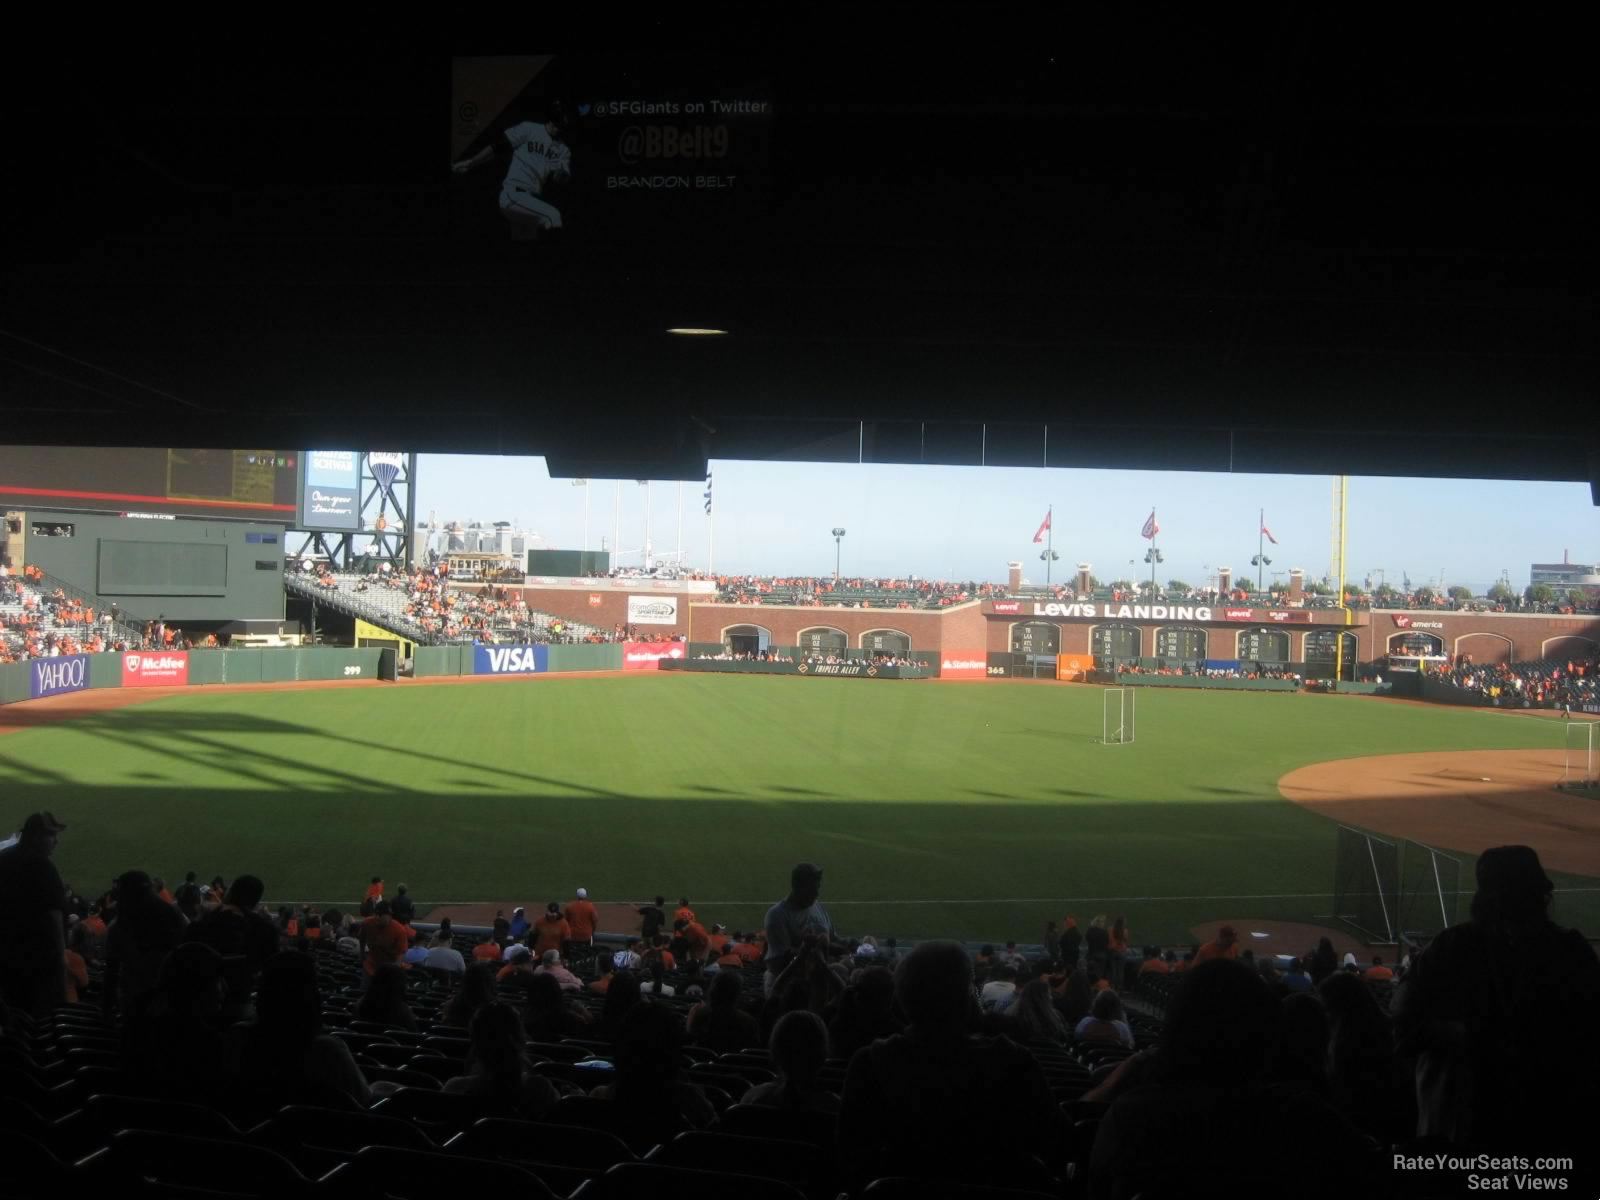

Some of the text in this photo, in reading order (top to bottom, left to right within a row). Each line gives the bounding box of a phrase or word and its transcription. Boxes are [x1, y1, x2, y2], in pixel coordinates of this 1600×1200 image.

[593, 99, 769, 117] @SFGiants on Twitter
[618, 125, 730, 165] @BBelt9
[606, 175, 738, 189] BRANDON BELT
[1104, 604, 1212, 621] LANDING
[1411, 621, 1443, 629] america
[142, 656, 185, 670] McAfee
[485, 647, 536, 672] VISA
[37, 657, 86, 694] YAHOO!
[344, 666, 361, 675] 399
[987, 666, 1005, 675] 365
